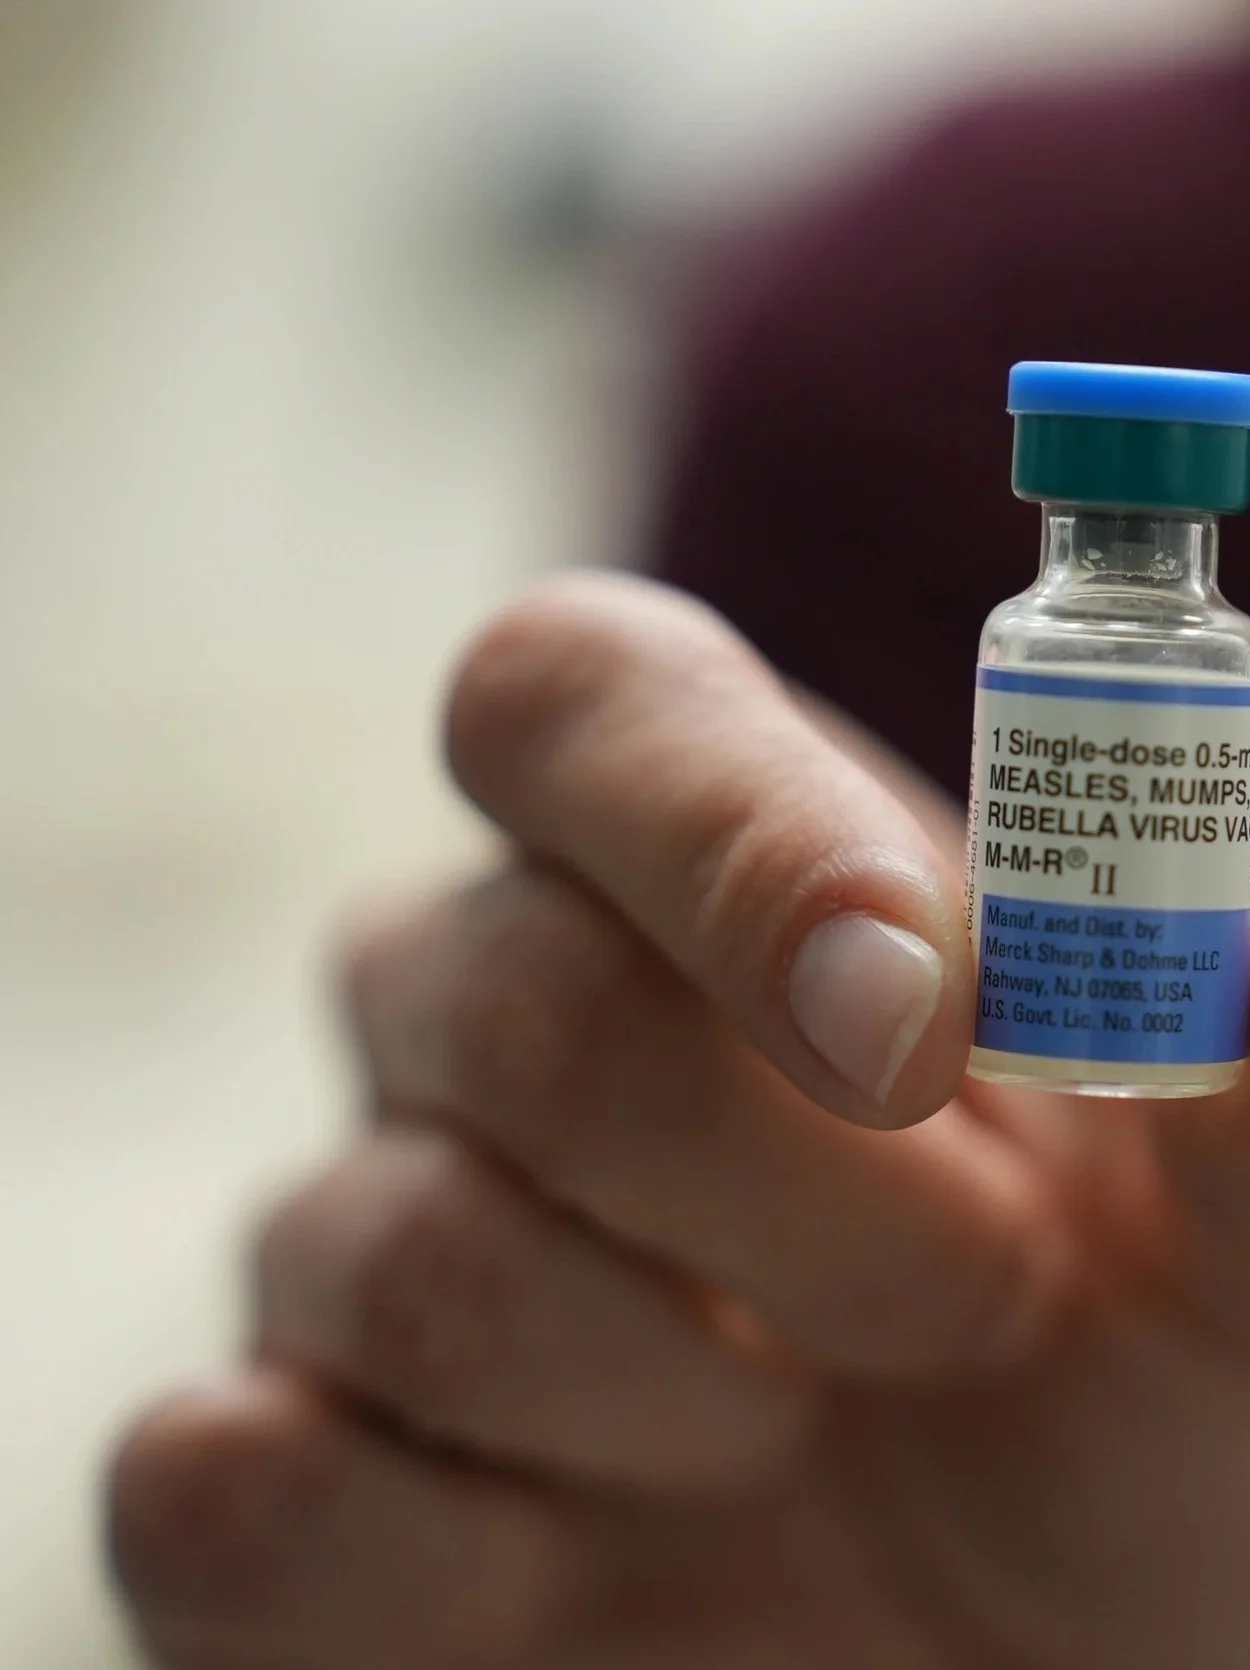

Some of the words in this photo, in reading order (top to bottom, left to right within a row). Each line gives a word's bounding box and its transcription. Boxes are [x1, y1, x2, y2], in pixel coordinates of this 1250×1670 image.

[992, 727, 1000, 753] 1
[1008, 728, 1187, 767] Single-dose
[989, 763, 1138, 806] MEASLES,
[1149, 777, 1250, 810] MUMPS,
[987, 800, 1120, 839] RUBELLA
[1129, 814, 1218, 843] VIRUS
[1090, 863, 1118, 896] II
[987, 904, 1038, 932] Manuf.
[1044, 914, 1080, 935] and
[1085, 916, 1129, 938] Dist.
[1135, 919, 1162, 944] by:
[985, 936, 1032, 962] Merck
[1037, 945, 1094, 970] Sharp
[1099, 947, 1115, 969] &
[1122, 948, 1188, 971] Dohme
[1192, 950, 1219, 971] LLC
[983, 966, 1048, 998] Rahway,
[1054, 976, 1082, 998] NJ
[1087, 978, 1148, 1003] 07065,
[1154, 981, 1193, 1003] USA
[981, 998, 1007, 1021] U.S.
[1013, 1003, 1057, 1026] Govt.
[1063, 1008, 1096, 1030] Lic.
[1102, 1010, 1137, 1032] No.
[1141, 1012, 1183, 1034] 0002
